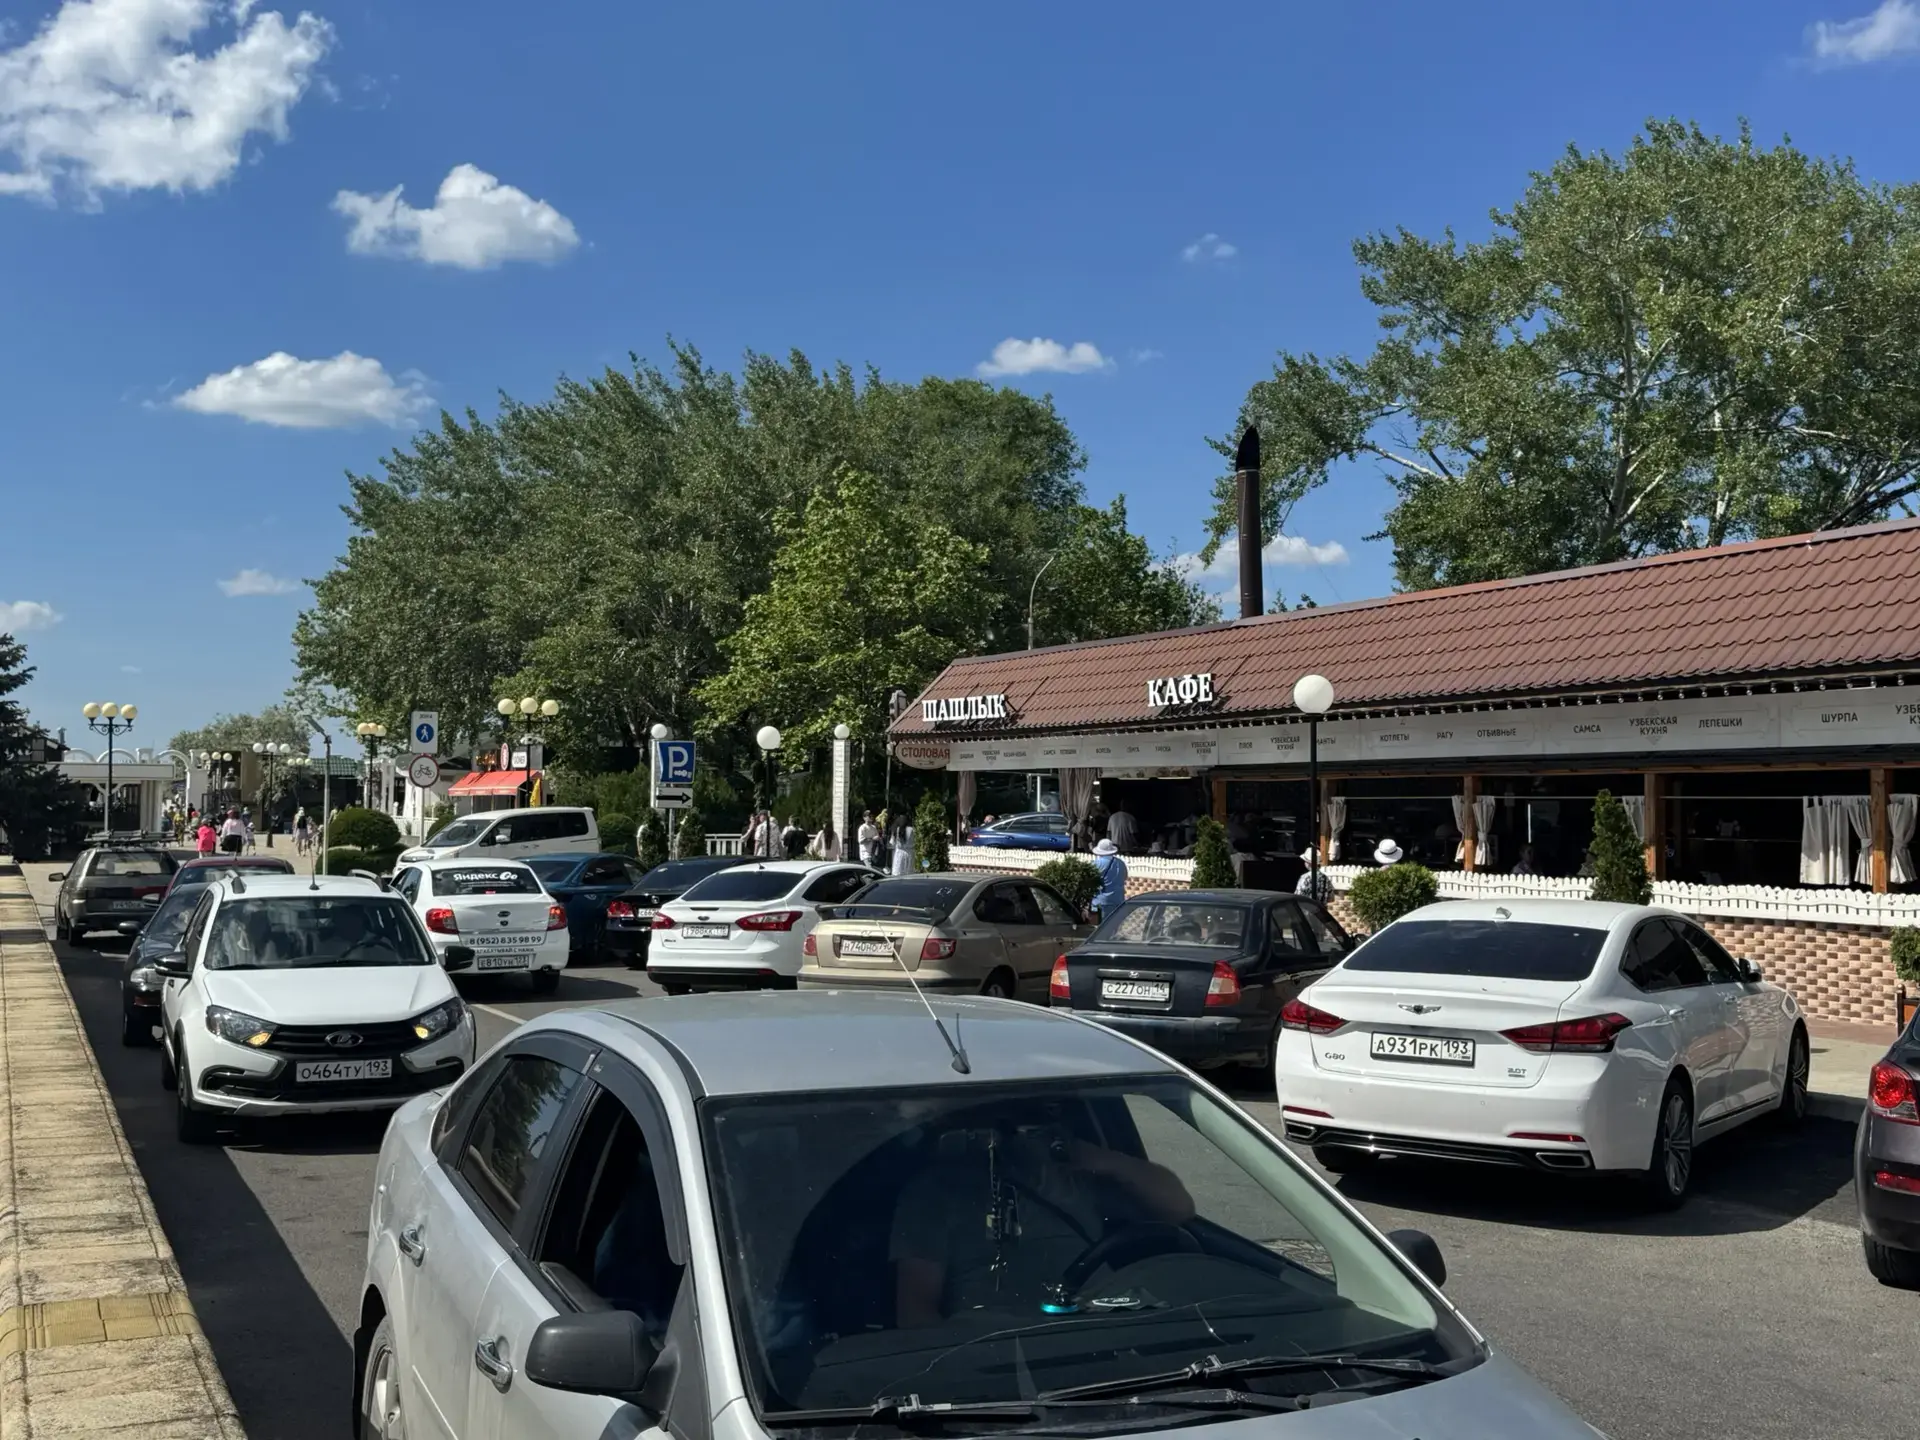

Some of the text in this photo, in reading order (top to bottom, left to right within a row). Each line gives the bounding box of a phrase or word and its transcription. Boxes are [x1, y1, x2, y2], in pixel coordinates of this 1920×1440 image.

[1147, 673, 1213, 707] КАФЕ
[922, 694, 1006, 722] ШАШЛЫК
[1629, 716, 1678, 726] УЗБЕКСКАЯ
[1698, 717, 1743, 728] ЛЕПЕШКИ
[1821, 712, 1858, 723] ШУРПА
[1477, 728, 1517, 738] ОТБИВНЫЕ
[1573, 724, 1602, 733] САМСА
[1640, 726, 1668, 735] КУХНЯ
[1380, 733, 1410, 742] КОТЛЕТЫ
[1437, 731, 1454, 740] РАГУ
[901, 746, 950, 759] СТОЛОВАЯ
[453, 873, 498, 881] Яндекс
[1106, 983, 1165, 995] С227ОН 14
[1376, 1037, 1468, 1056] А931РК 193
[1324, 1052, 1345, 1060] G80
[301, 1060, 388, 1079] О464ТУ 193
